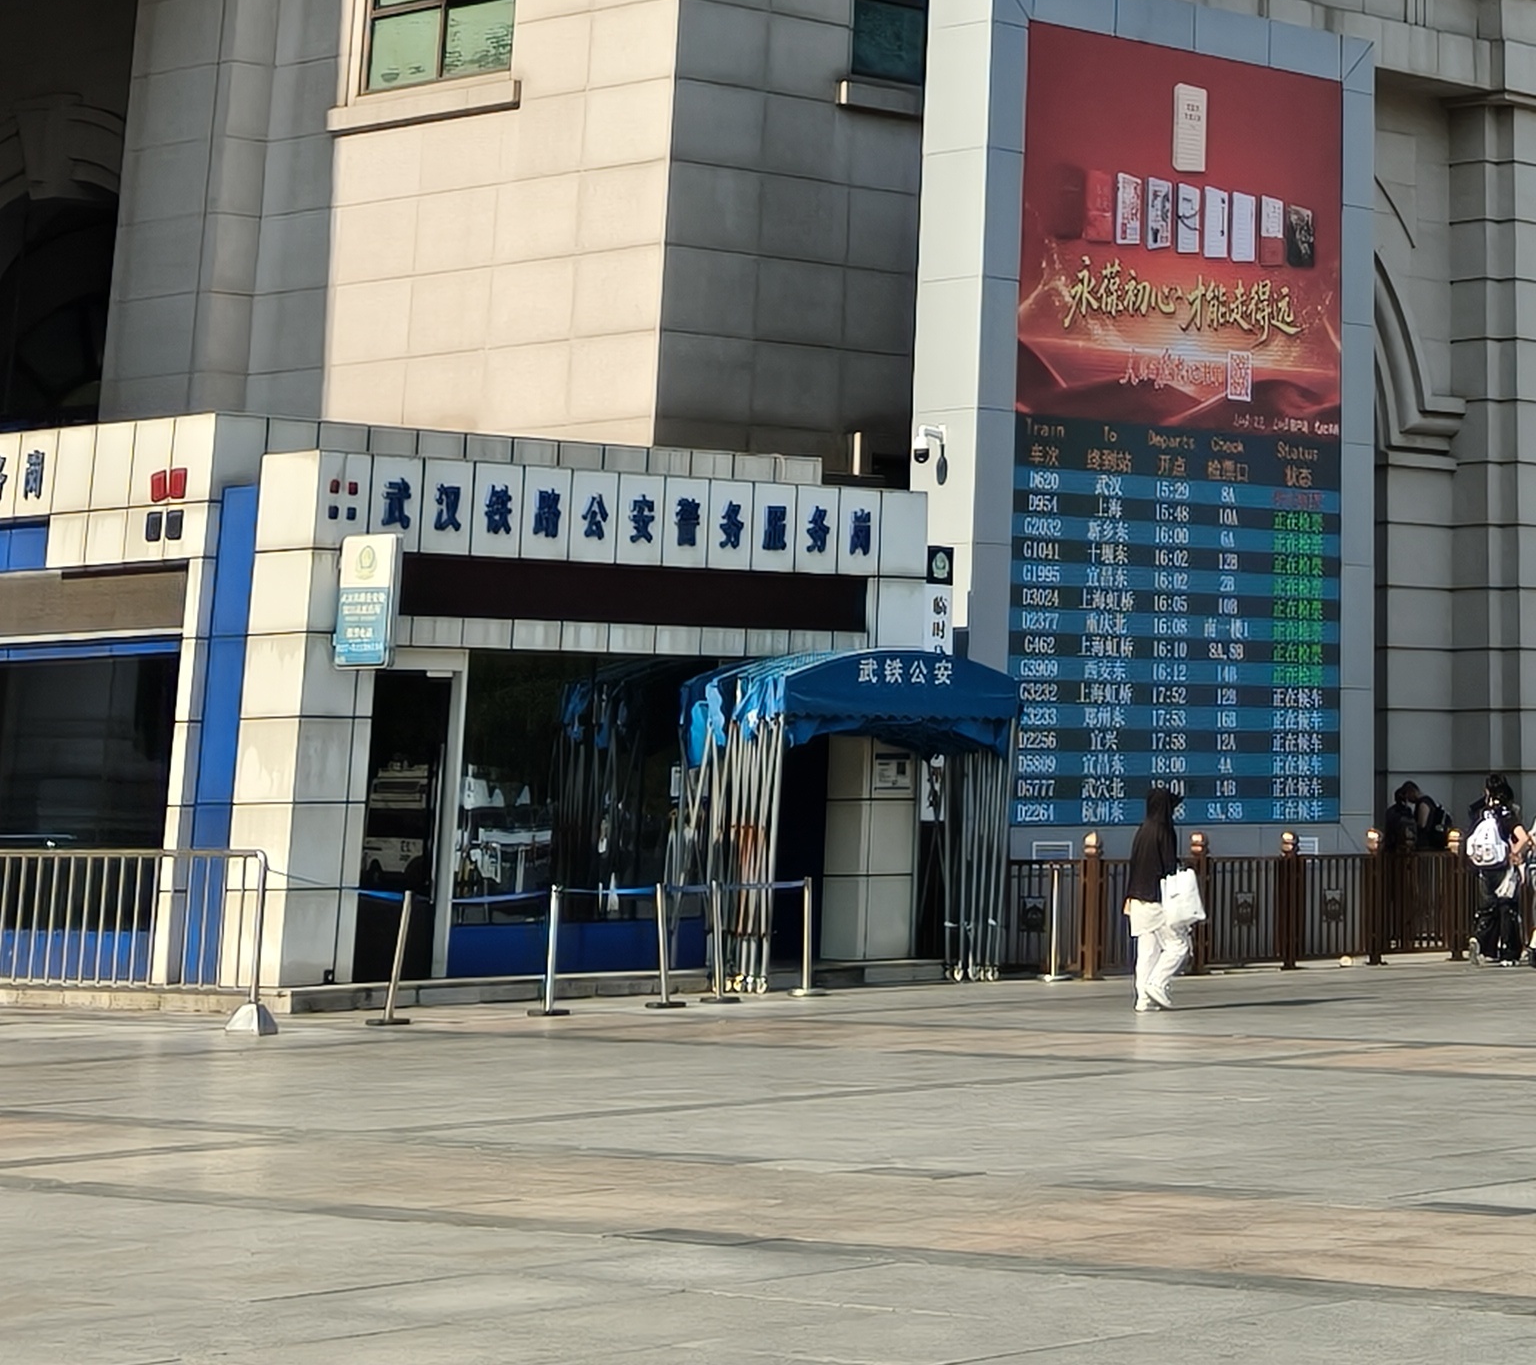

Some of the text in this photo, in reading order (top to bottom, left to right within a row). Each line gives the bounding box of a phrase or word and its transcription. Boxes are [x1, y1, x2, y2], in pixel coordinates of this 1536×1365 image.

[1026, 418, 1319, 462] Train To Departs Check Status
[1029, 443, 1313, 487] 车次 终到站 开点 检票口 状态
[1095, 475, 1122, 495] 武汉
[1156, 481, 1189, 499] 15:29
[381, 477, 871, 556] 武汉铁路公安警务服务岗
[1094, 498, 1122, 518] 上海
[1155, 504, 1189, 522] 15:48
[1155, 526, 1189, 544] 16:00
[1154, 550, 1189, 567] 16:02
[1153, 572, 1188, 590] 16:02
[1153, 595, 1188, 612] 16:05
[1153, 640, 1188, 658] 16:10
[858, 658, 953, 685] 武铁公安
[1152, 663, 1187, 681] 16:12
[1152, 687, 1187, 705] 17:52
[1151, 757, 1186, 774] 18:00
